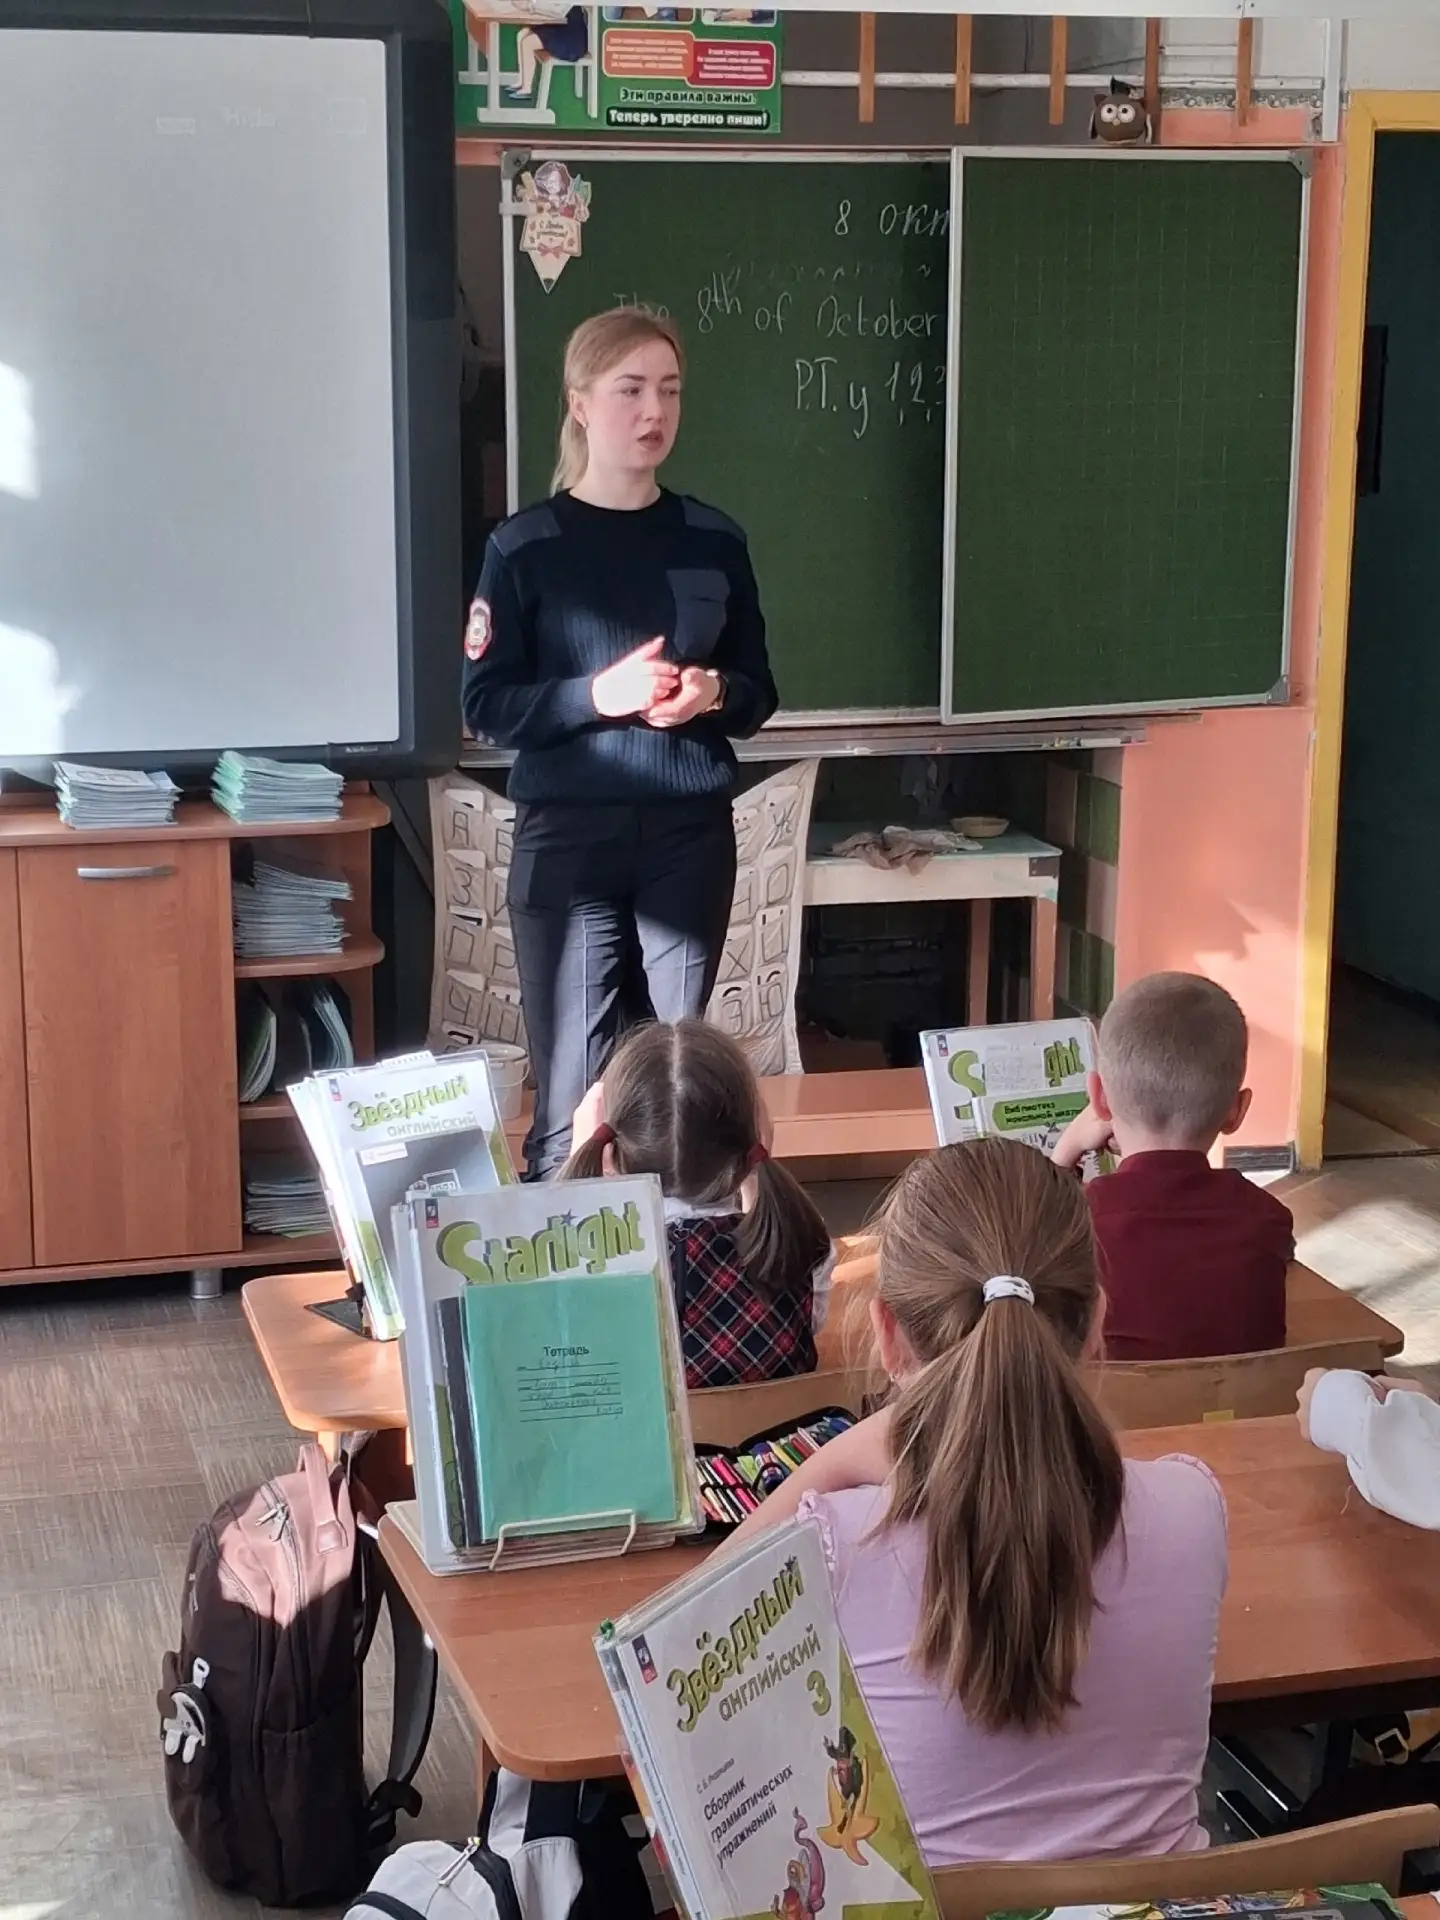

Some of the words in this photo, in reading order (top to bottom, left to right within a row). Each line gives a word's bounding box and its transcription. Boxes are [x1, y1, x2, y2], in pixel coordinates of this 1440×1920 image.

[610, 109, 658, 126] Теперь
[660, 112, 724, 126] уверенно
[726, 110, 768, 127] пиши!
[620, 88, 645, 100] Эти
[648, 91, 704, 104] правила
[834, 199, 851, 236] 8
[697, 272, 742, 334] 8th
[754, 291, 792, 335] of
[816, 294, 938, 340] October
[347, 1071, 470, 1132] Звёздный
[386, 1110, 478, 1138] английский
[436, 1200, 645, 1285] Starlight
[666, 1555, 805, 1733] Звёздный
[718, 1622, 822, 1722] английский
[806, 1669, 832, 1717] 3
[703, 1775, 747, 1821] Сборник
[710, 1764, 795, 1844] грамматических
[716, 1799, 778, 1870] упражнений
